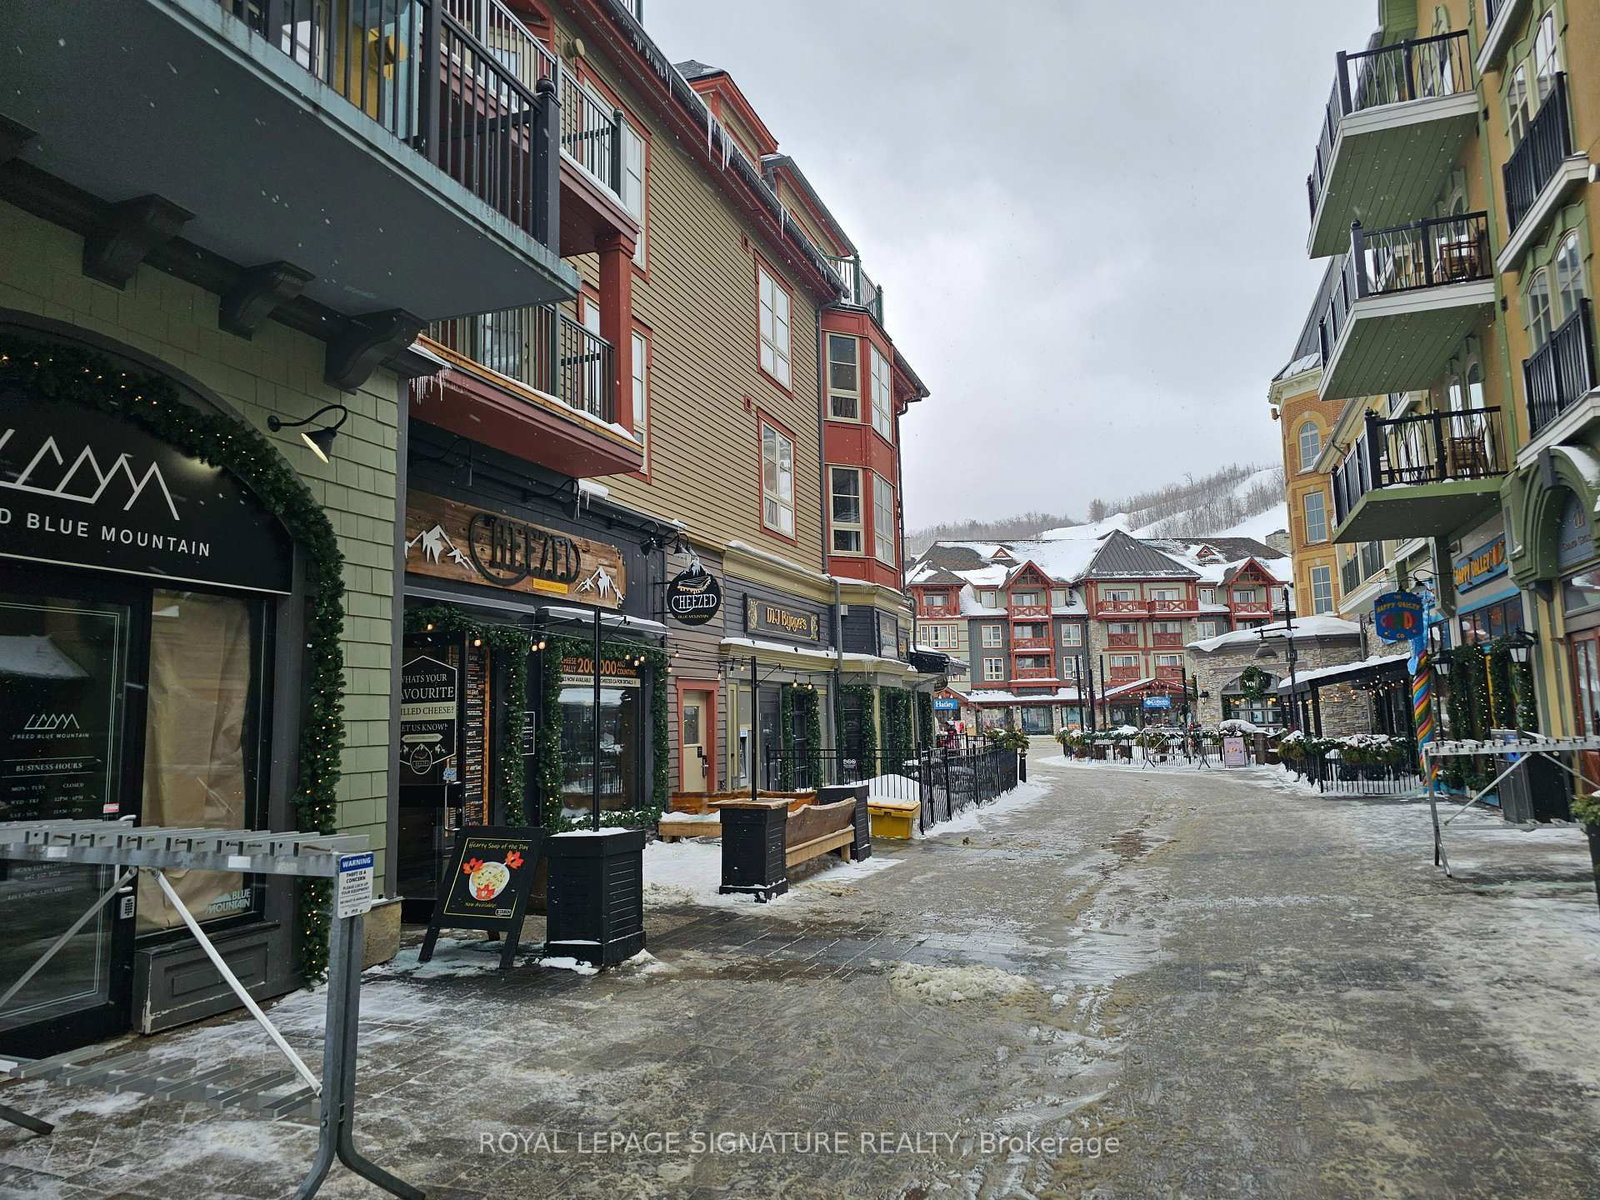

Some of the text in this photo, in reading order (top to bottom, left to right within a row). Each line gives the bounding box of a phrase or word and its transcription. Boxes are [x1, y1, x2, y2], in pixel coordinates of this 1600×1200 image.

[26, 513, 89, 537] BLUE
[101, 525, 210, 557] MOUNTAIN
[671, 593, 717, 613] CHEEZED
[425, 673, 447, 683] YOUR
[400, 686, 455, 700] VOURITE
[400, 705, 455, 716] ILLED CHEESE?
[411, 723, 420, 731] US
[16, 762, 83, 772] BUSINESS HOURS
[342, 857, 371, 869] WARNING
[346, 876, 366, 884] CONCERN
[232, 888, 251, 900] BLUE
[206, 898, 251, 914] MOUNTAIN
